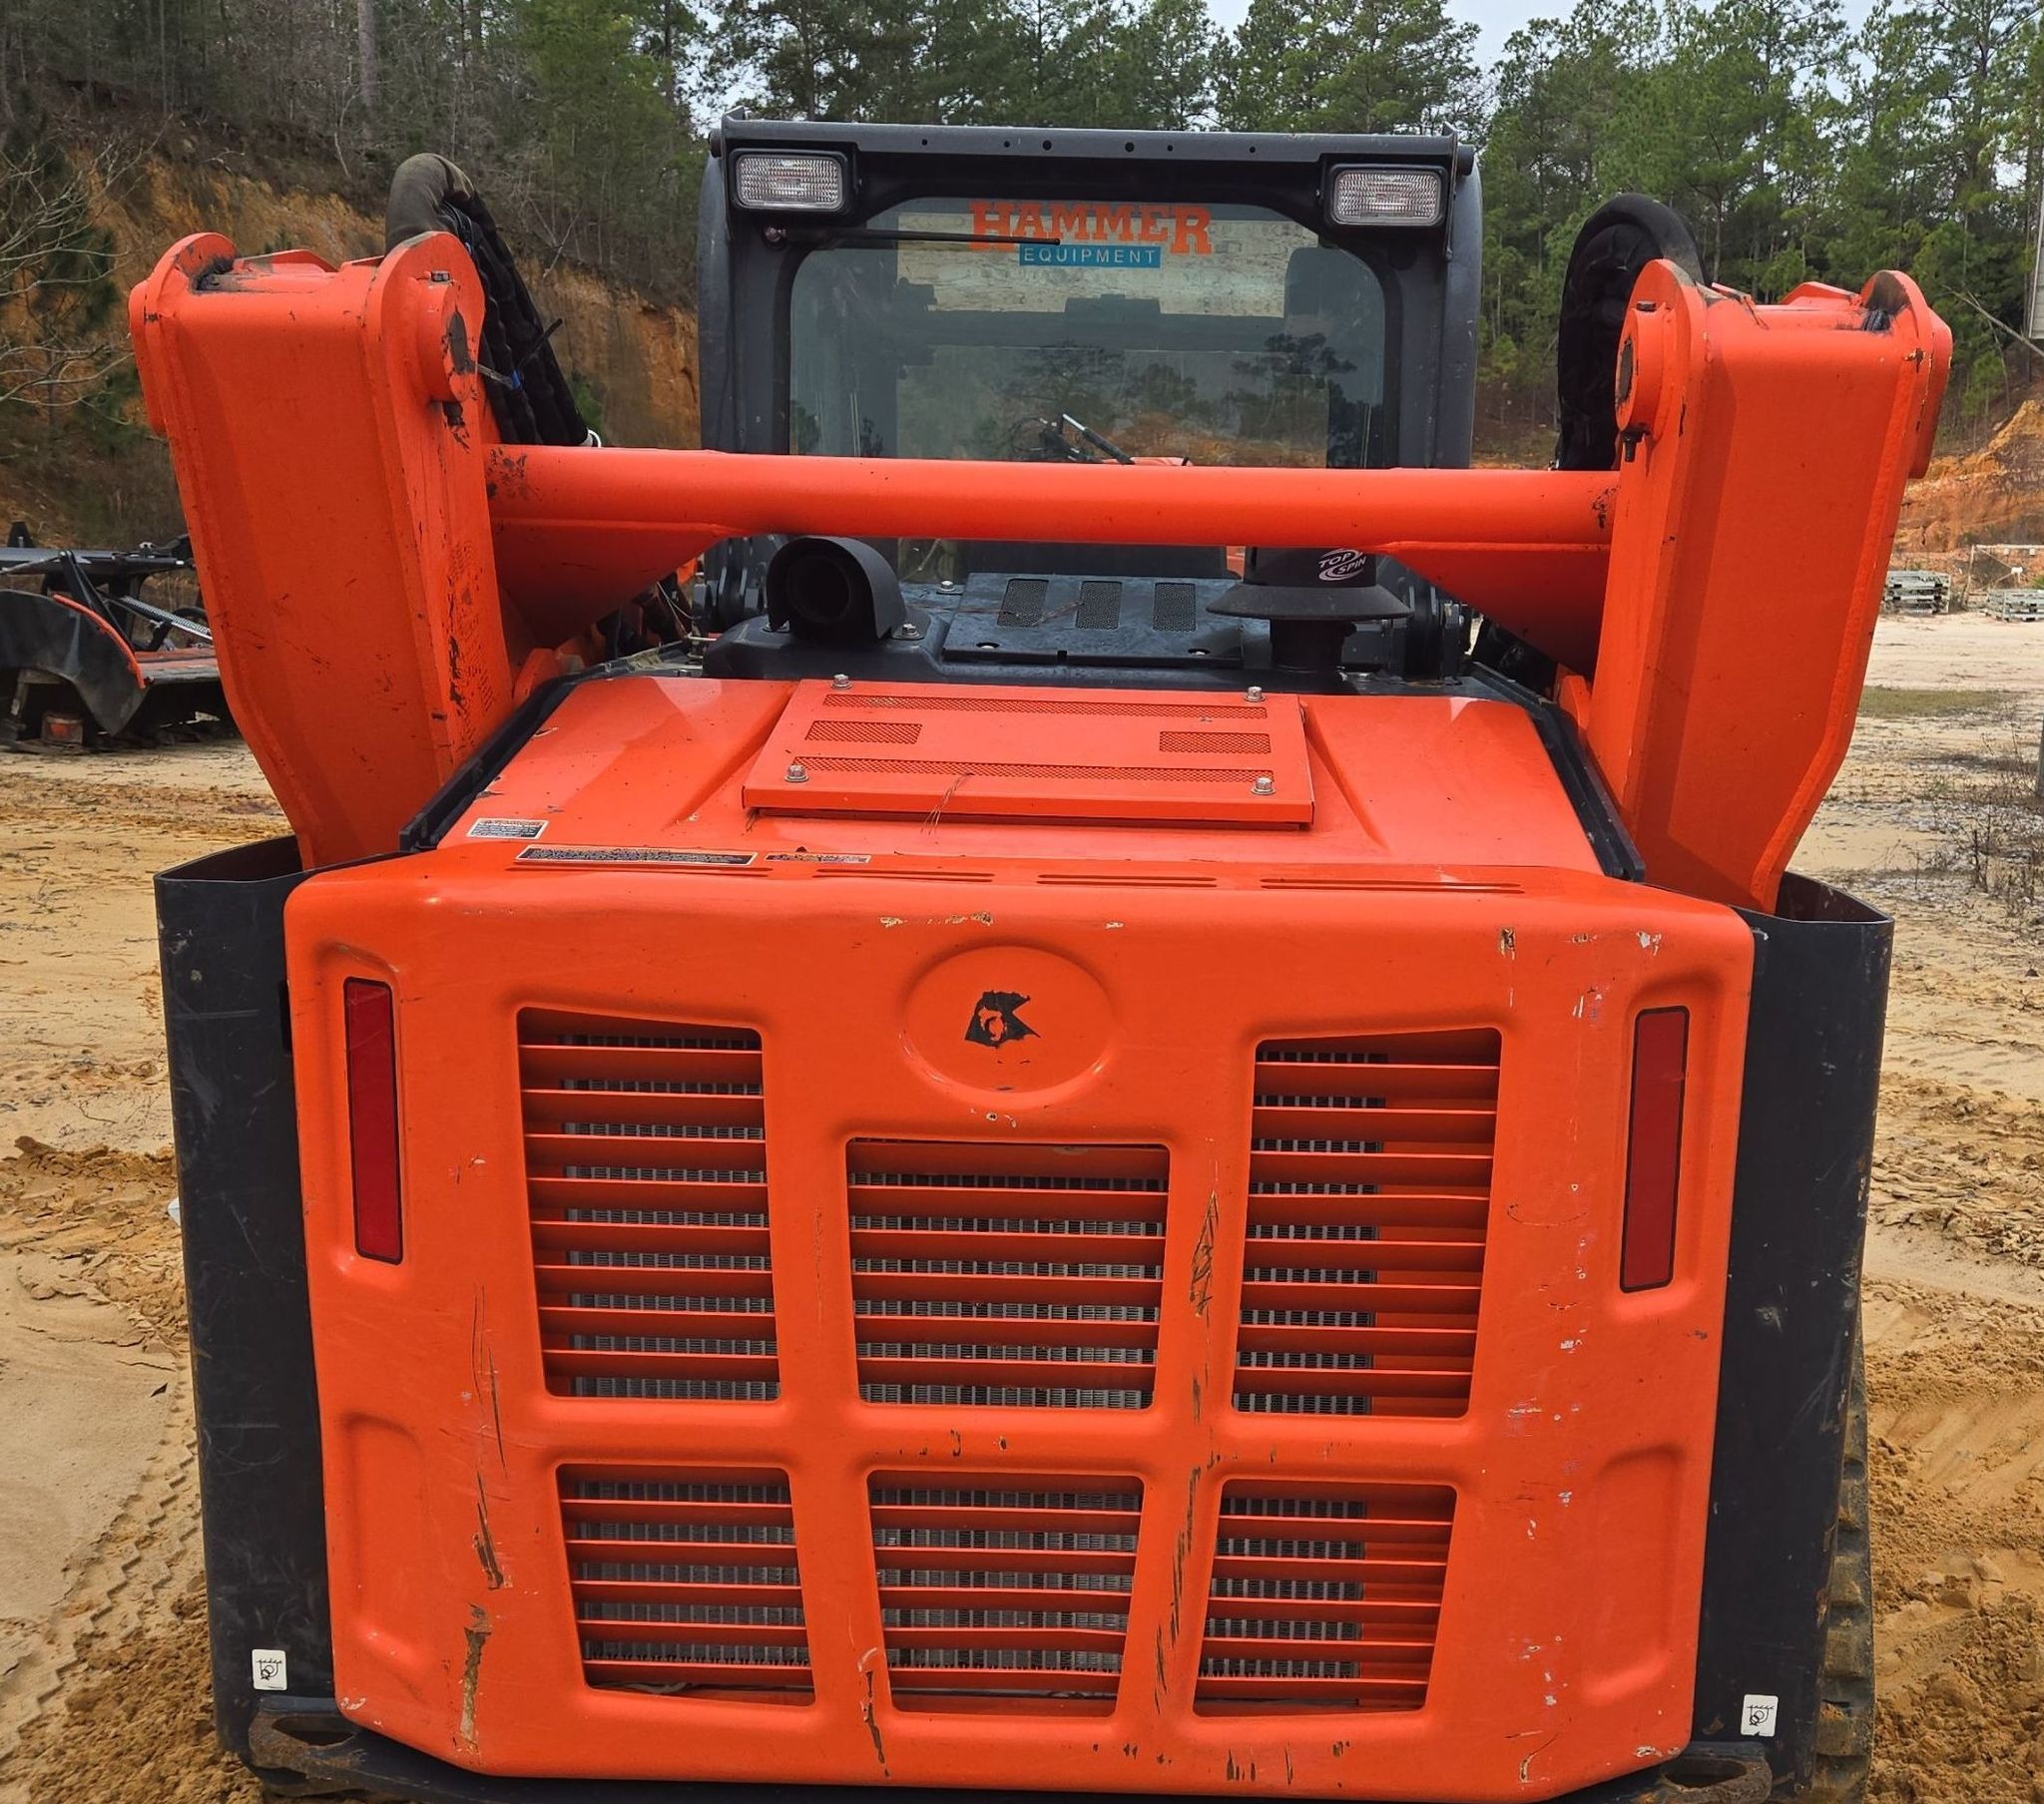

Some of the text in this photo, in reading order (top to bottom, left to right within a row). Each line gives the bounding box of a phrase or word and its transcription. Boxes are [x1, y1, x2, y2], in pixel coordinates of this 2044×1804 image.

[969, 202, 1213, 255] HAMMER
[1024, 247, 1155, 264] EQUIPMENT
[1318, 553, 1351, 569] TOP
[1338, 556, 1367, 574] SPIN
